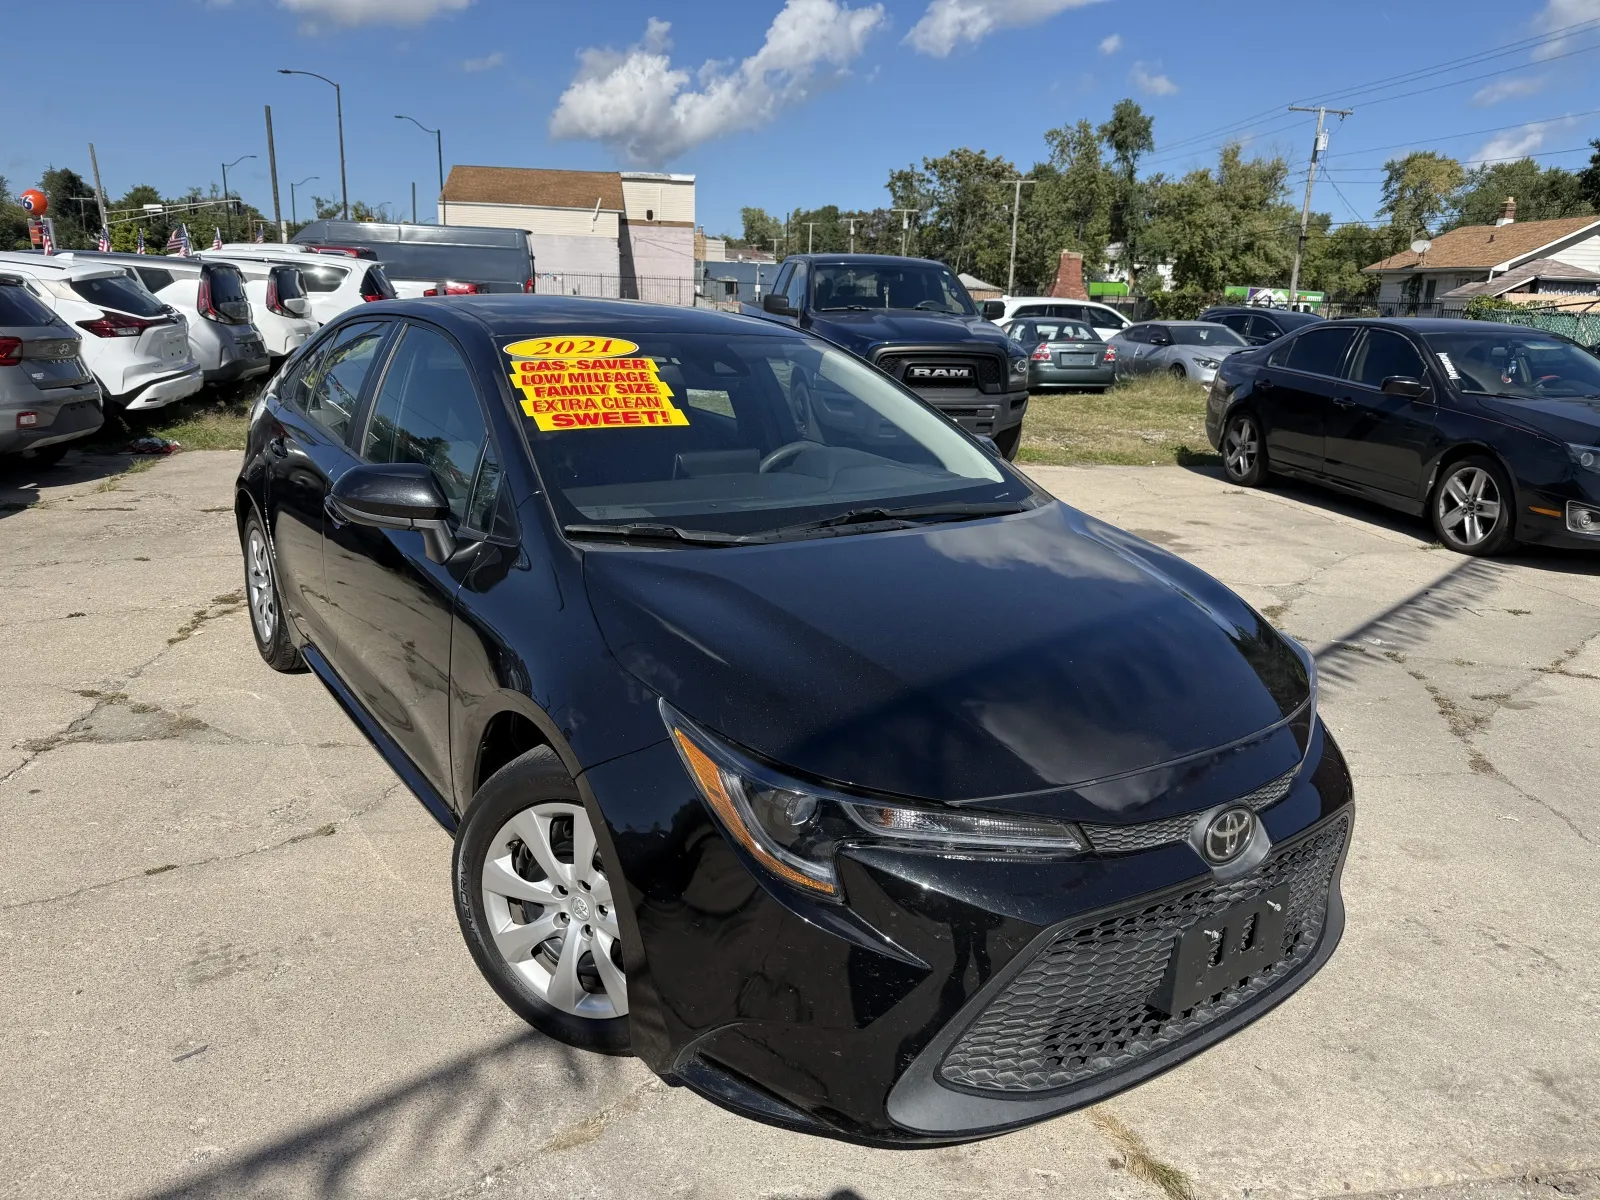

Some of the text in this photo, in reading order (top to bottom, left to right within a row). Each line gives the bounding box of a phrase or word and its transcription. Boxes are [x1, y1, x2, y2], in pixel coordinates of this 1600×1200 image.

[532, 339, 614, 356] 2021
[520, 359, 648, 373] GAS-SAVER
[913, 368, 969, 377] RAM
[521, 371, 652, 387] LOW MILEAGE
[534, 382, 659, 398] FAMILY SIZE
[532, 396, 662, 414] EXTRA CLEAN
[552, 411, 672, 427] SWEET!
